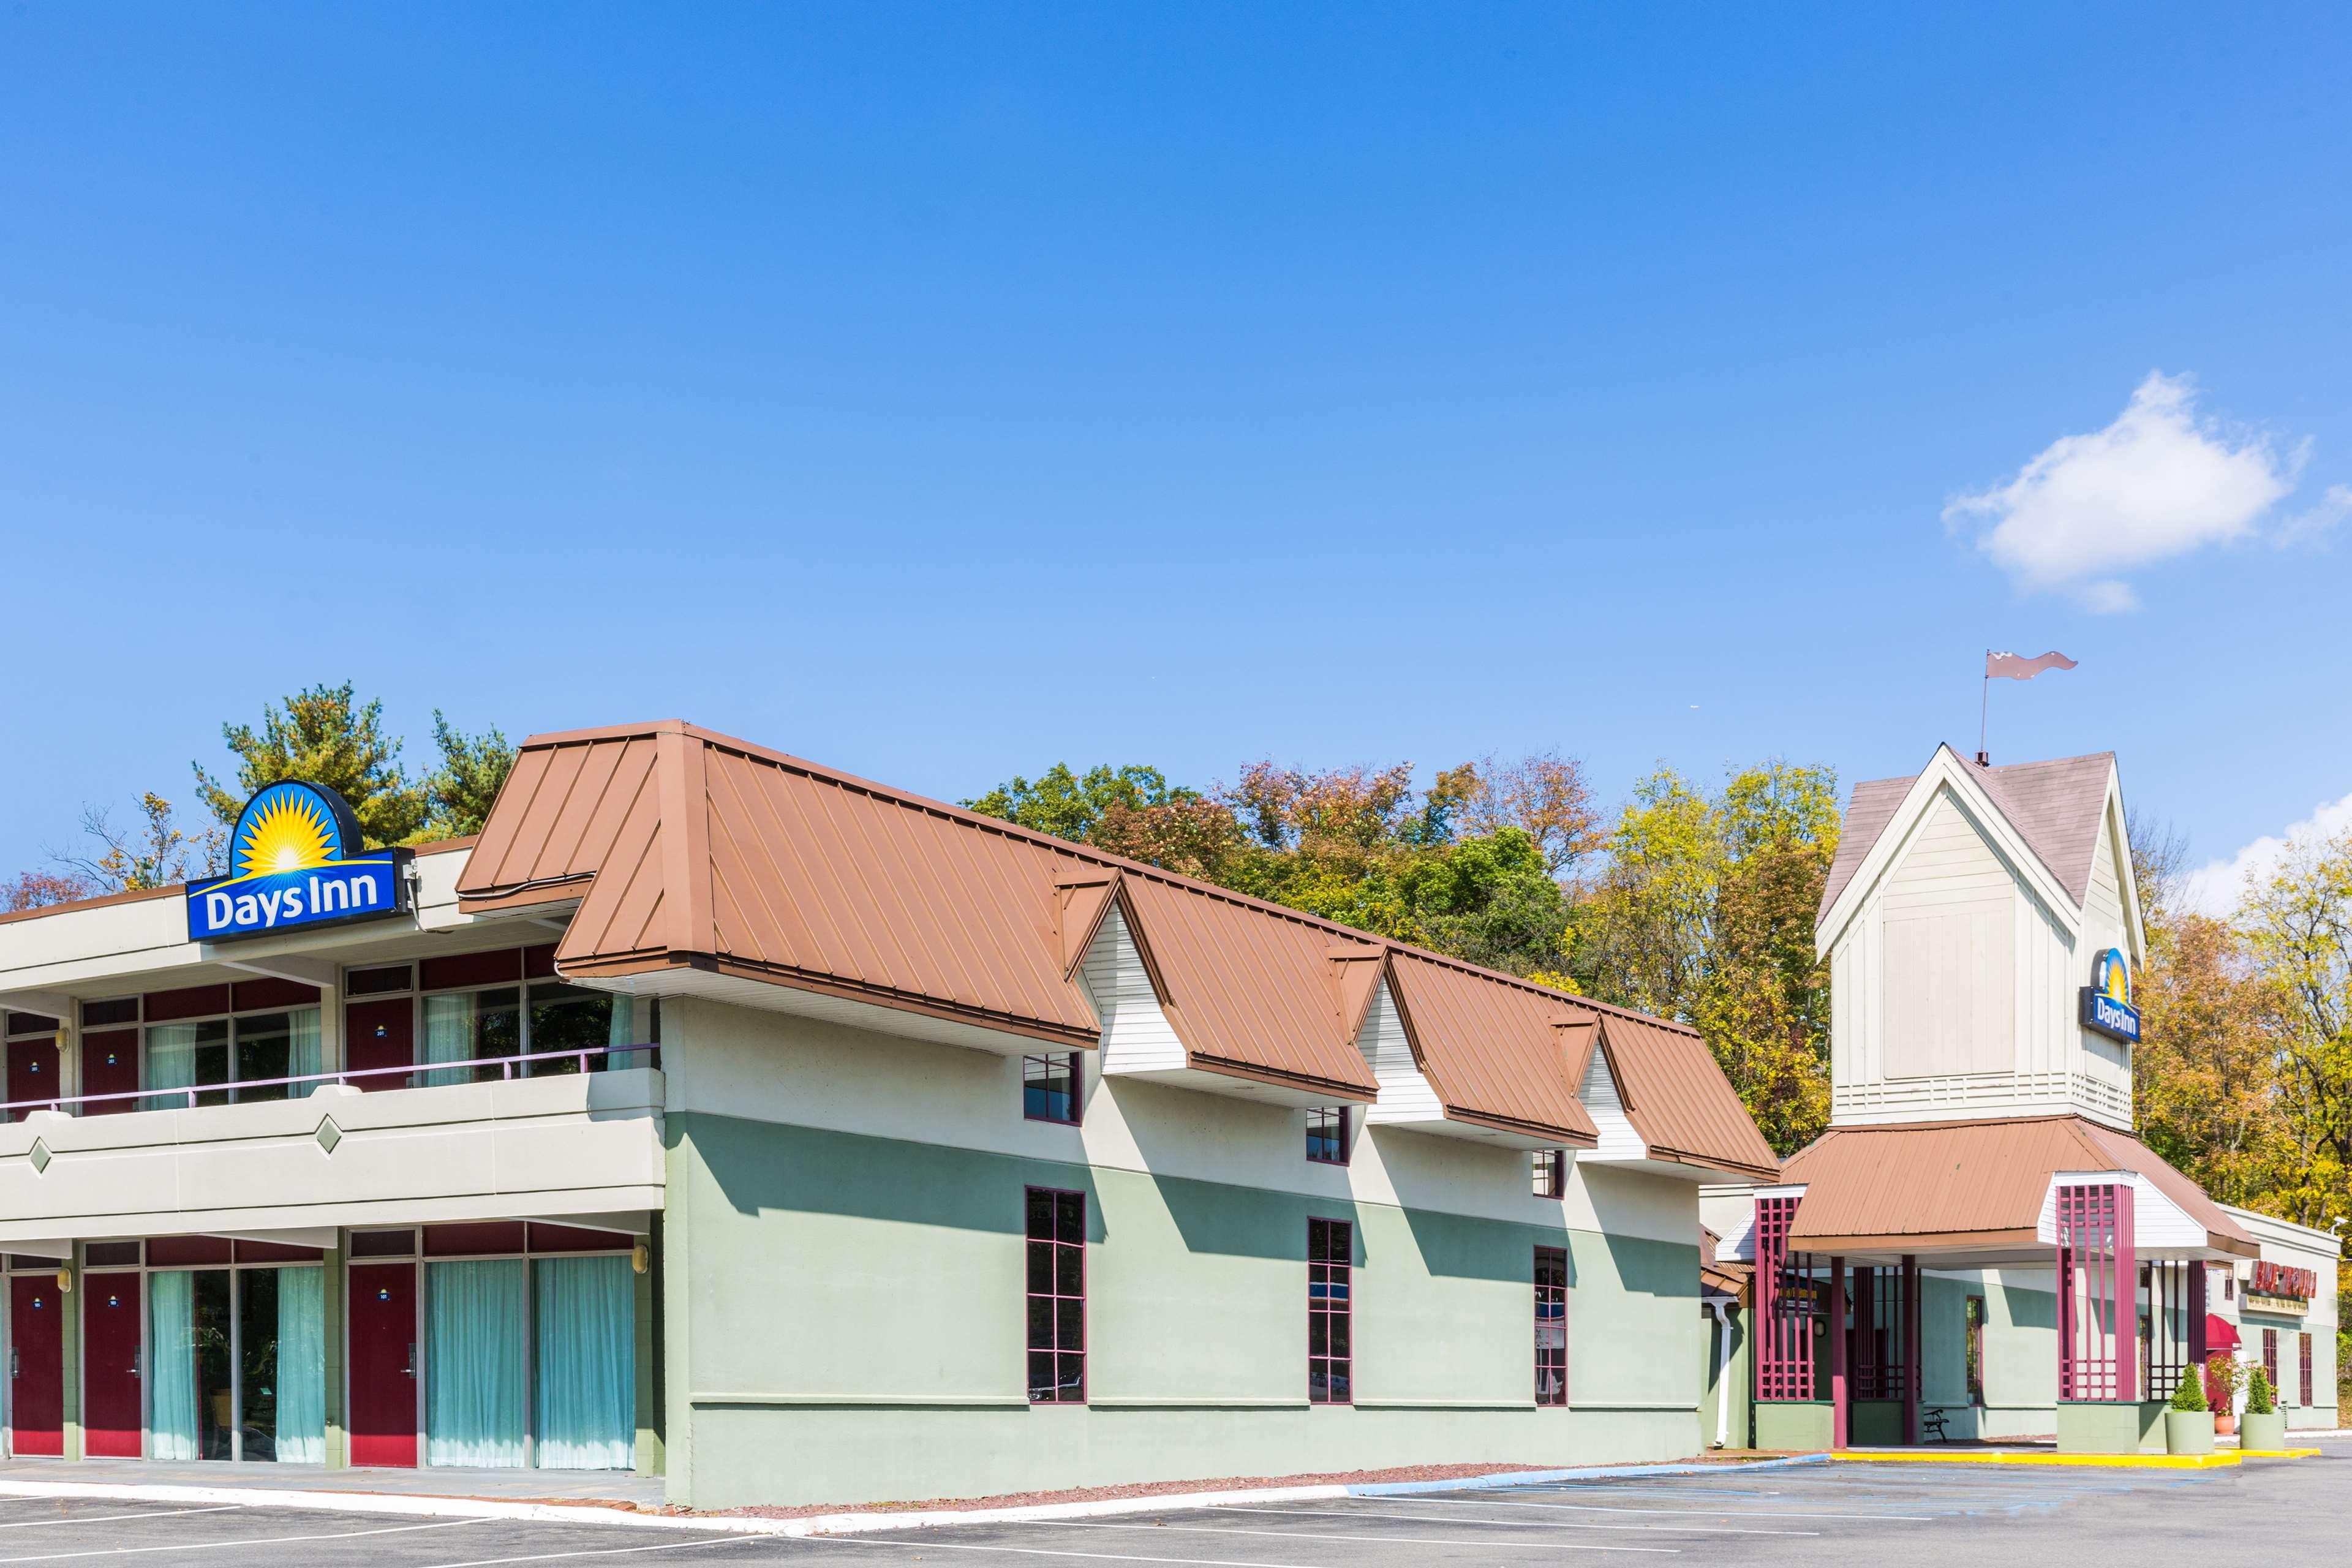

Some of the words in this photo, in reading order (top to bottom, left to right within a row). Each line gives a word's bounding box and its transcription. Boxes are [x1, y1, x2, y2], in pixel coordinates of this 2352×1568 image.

[206, 887, 304, 930] Days
[309, 875, 377, 914] Inn
[2097, 997, 2120, 1029] Days
[2121, 1008, 2136, 1035] Inn
